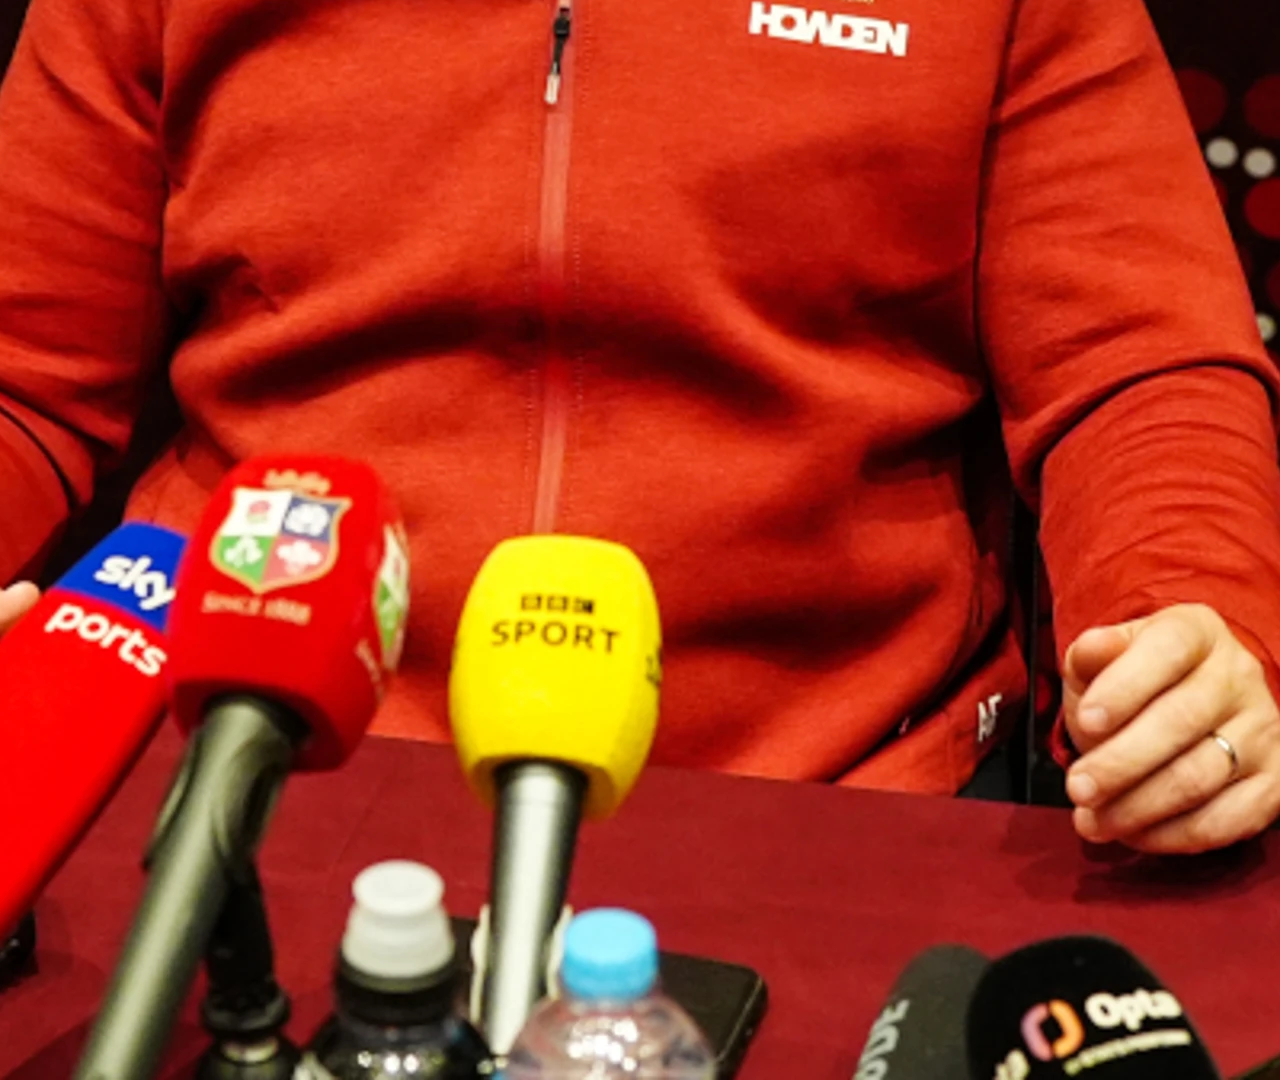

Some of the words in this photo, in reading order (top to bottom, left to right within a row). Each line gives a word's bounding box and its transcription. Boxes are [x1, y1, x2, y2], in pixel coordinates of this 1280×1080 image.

[748, 0, 910, 57] HOWDEN
[93, 554, 177, 611] sky
[44, 603, 168, 677] ports
[491, 621, 620, 655] SPORT
[1085, 987, 1183, 1031] Opta
